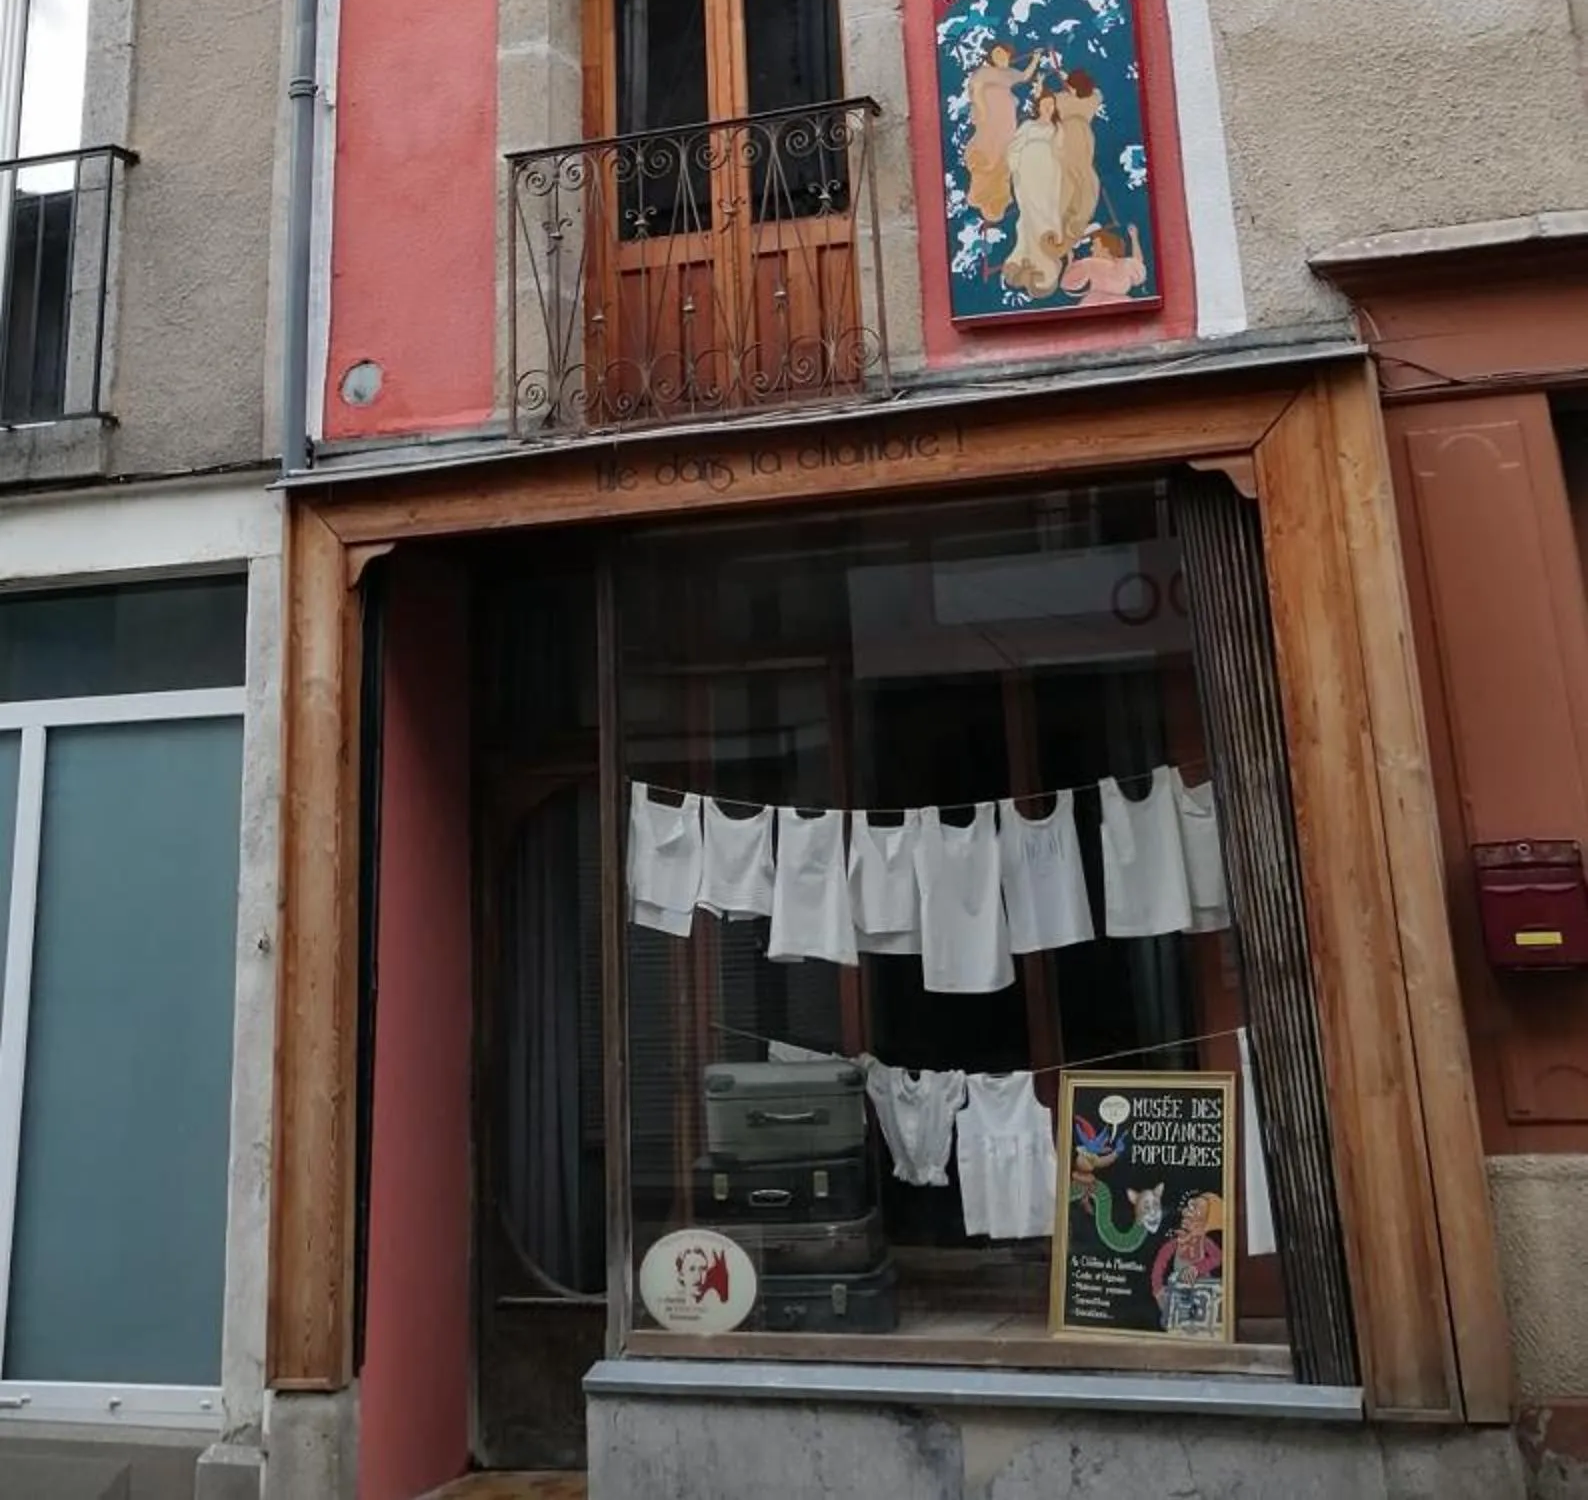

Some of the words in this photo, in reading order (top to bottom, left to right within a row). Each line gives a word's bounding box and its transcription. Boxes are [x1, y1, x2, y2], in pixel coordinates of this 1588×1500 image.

[1132, 1094, 1183, 1118] MUSÉE
[1191, 1097, 1221, 1119] DES
[1132, 1121, 1222, 1143] CROYANCES
[1131, 1144, 1222, 1167] POPULAIRES
